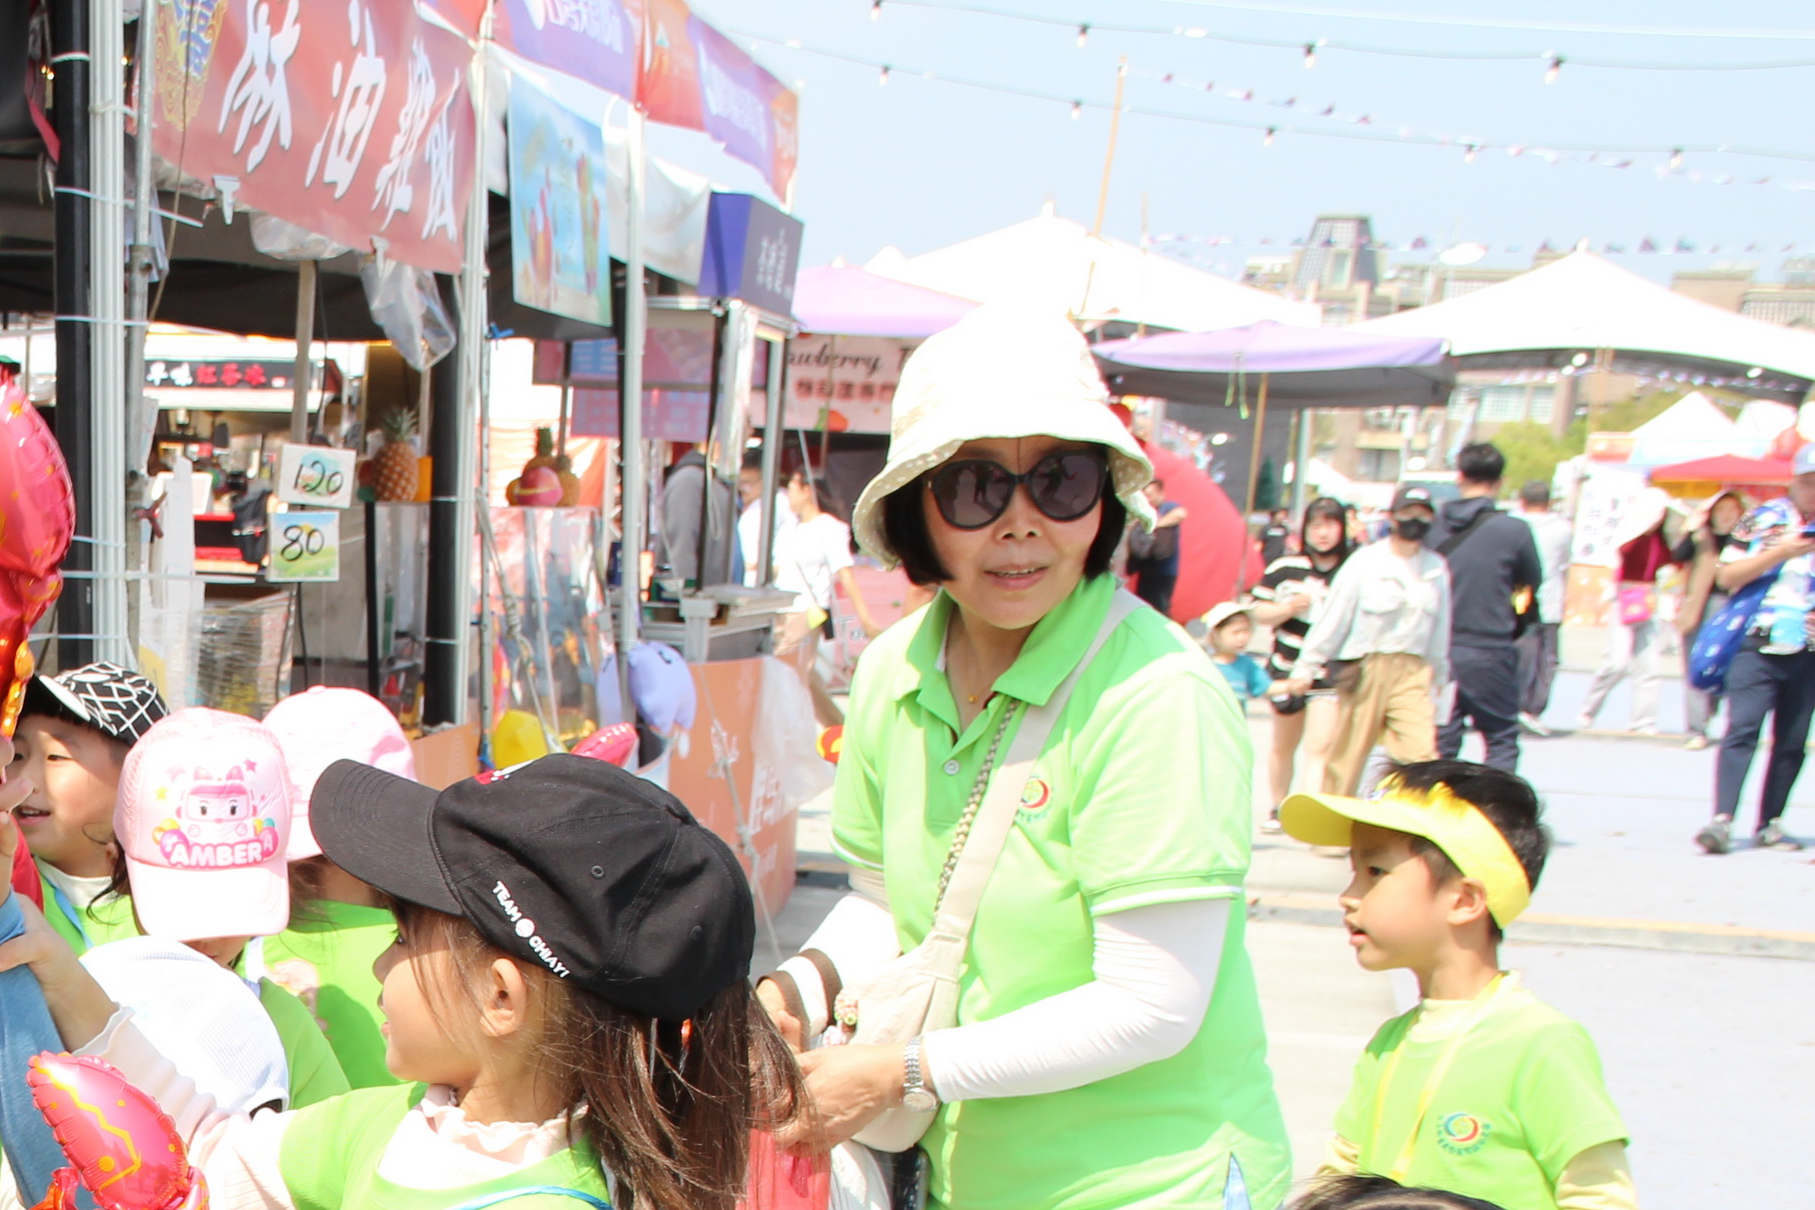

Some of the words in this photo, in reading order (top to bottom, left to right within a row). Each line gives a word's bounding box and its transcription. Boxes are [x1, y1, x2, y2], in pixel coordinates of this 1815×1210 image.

[293, 459, 345, 496] 120
[280, 524, 325, 562] 80
[169, 841, 263, 867] AMBER
[492, 880, 523, 922] TEAM
[528, 935, 571, 978] CHIAYI
